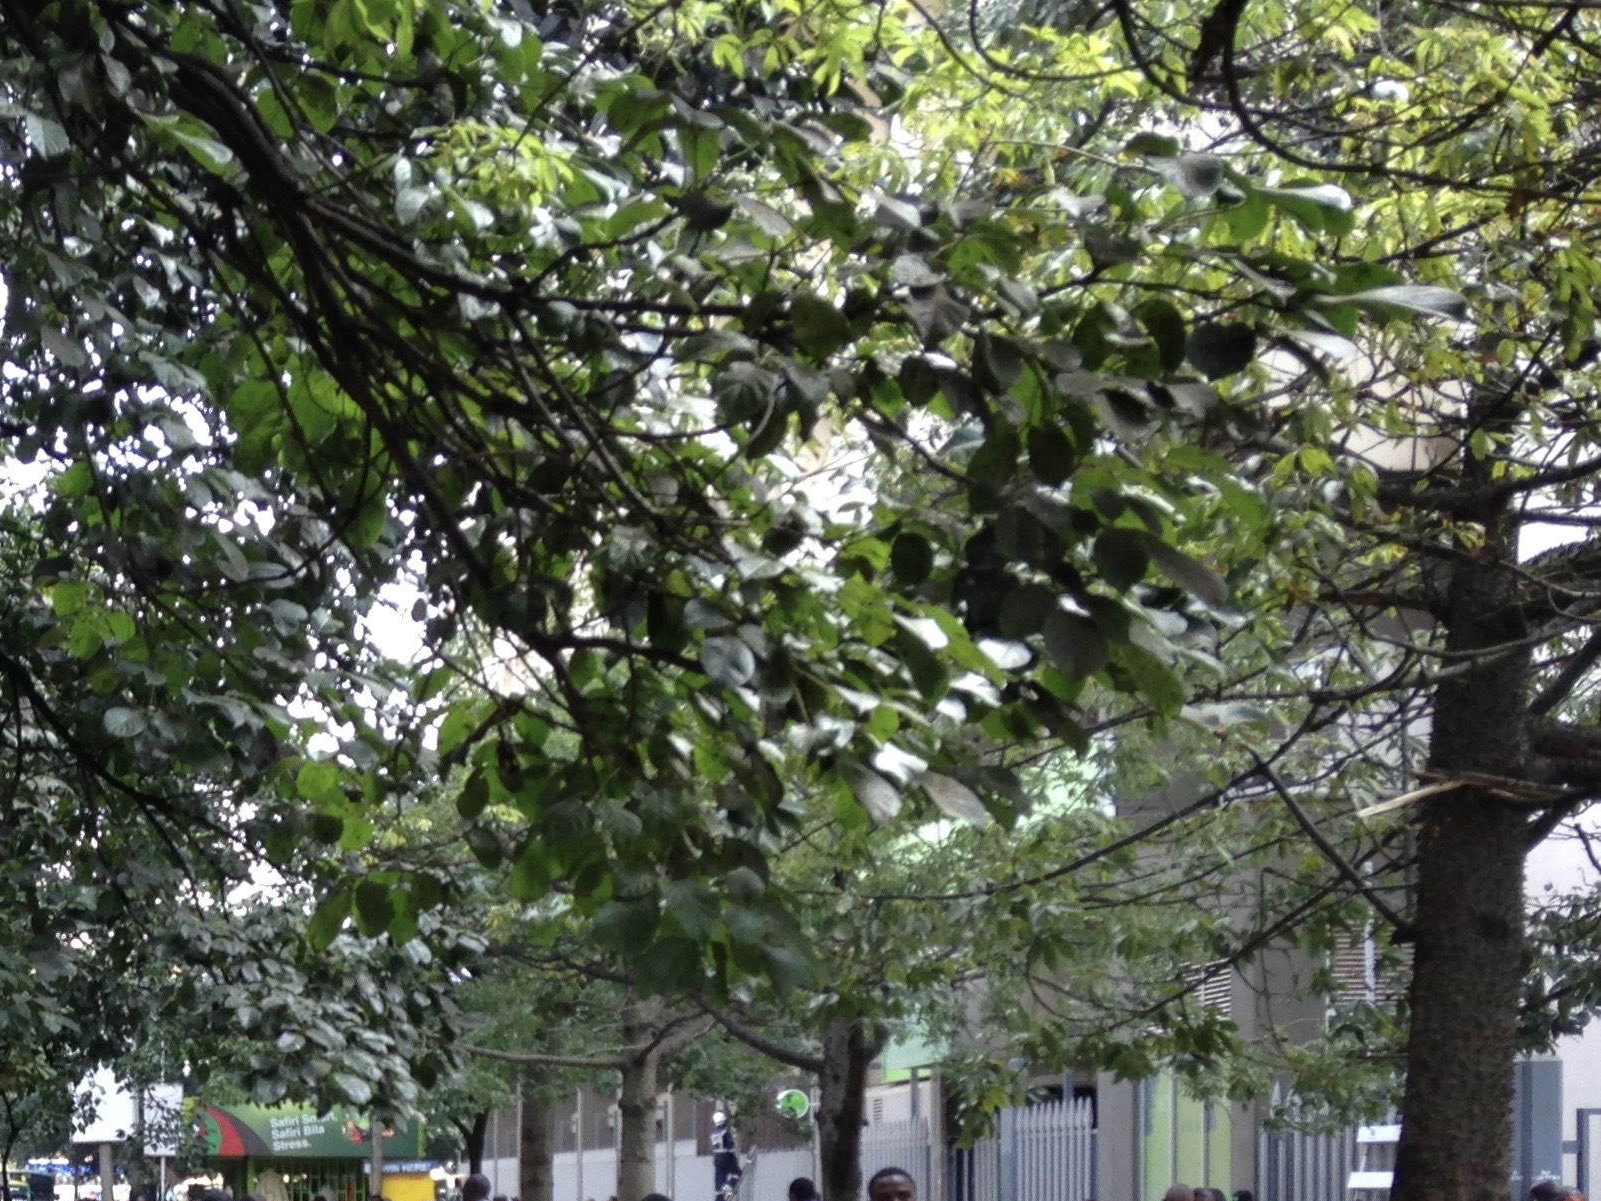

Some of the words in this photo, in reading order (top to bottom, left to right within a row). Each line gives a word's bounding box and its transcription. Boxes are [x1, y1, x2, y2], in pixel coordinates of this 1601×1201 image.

[270, 1116, 299, 1128] Safiri
[302, 1111, 338, 1124] Smt,
[271, 1127, 301, 1139] Safiri
